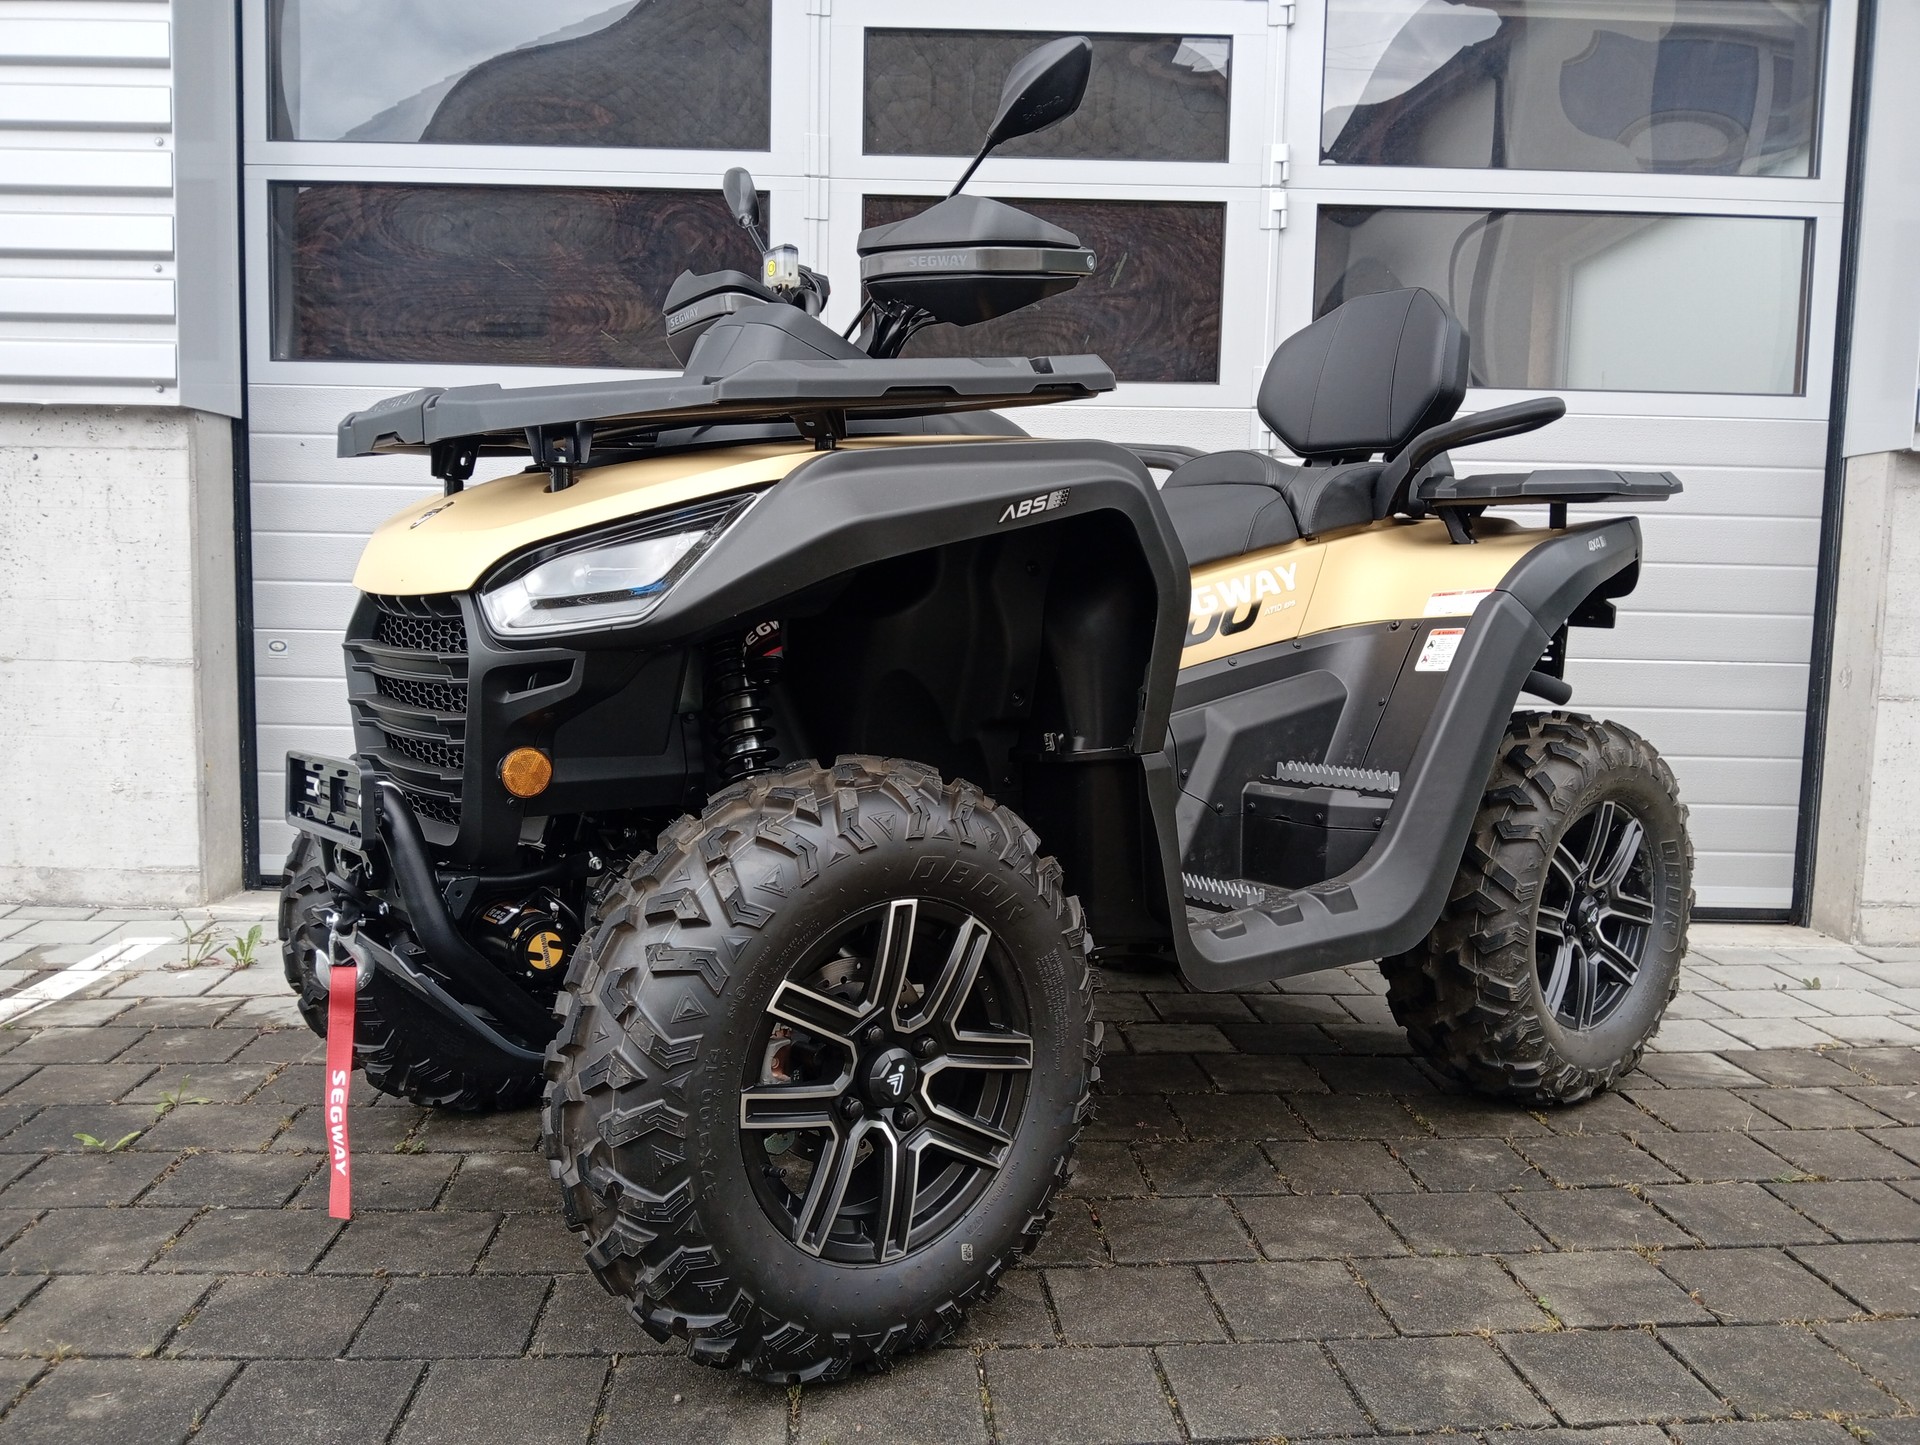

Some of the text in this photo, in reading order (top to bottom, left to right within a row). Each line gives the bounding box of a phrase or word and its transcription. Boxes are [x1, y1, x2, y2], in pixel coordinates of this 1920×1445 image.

[908, 254, 967, 268] SEGWAY
[670, 306, 699, 328] SEGWAY
[998, 494, 1049, 523] ABS
[329, 1069, 347, 1177] SEGWAY
